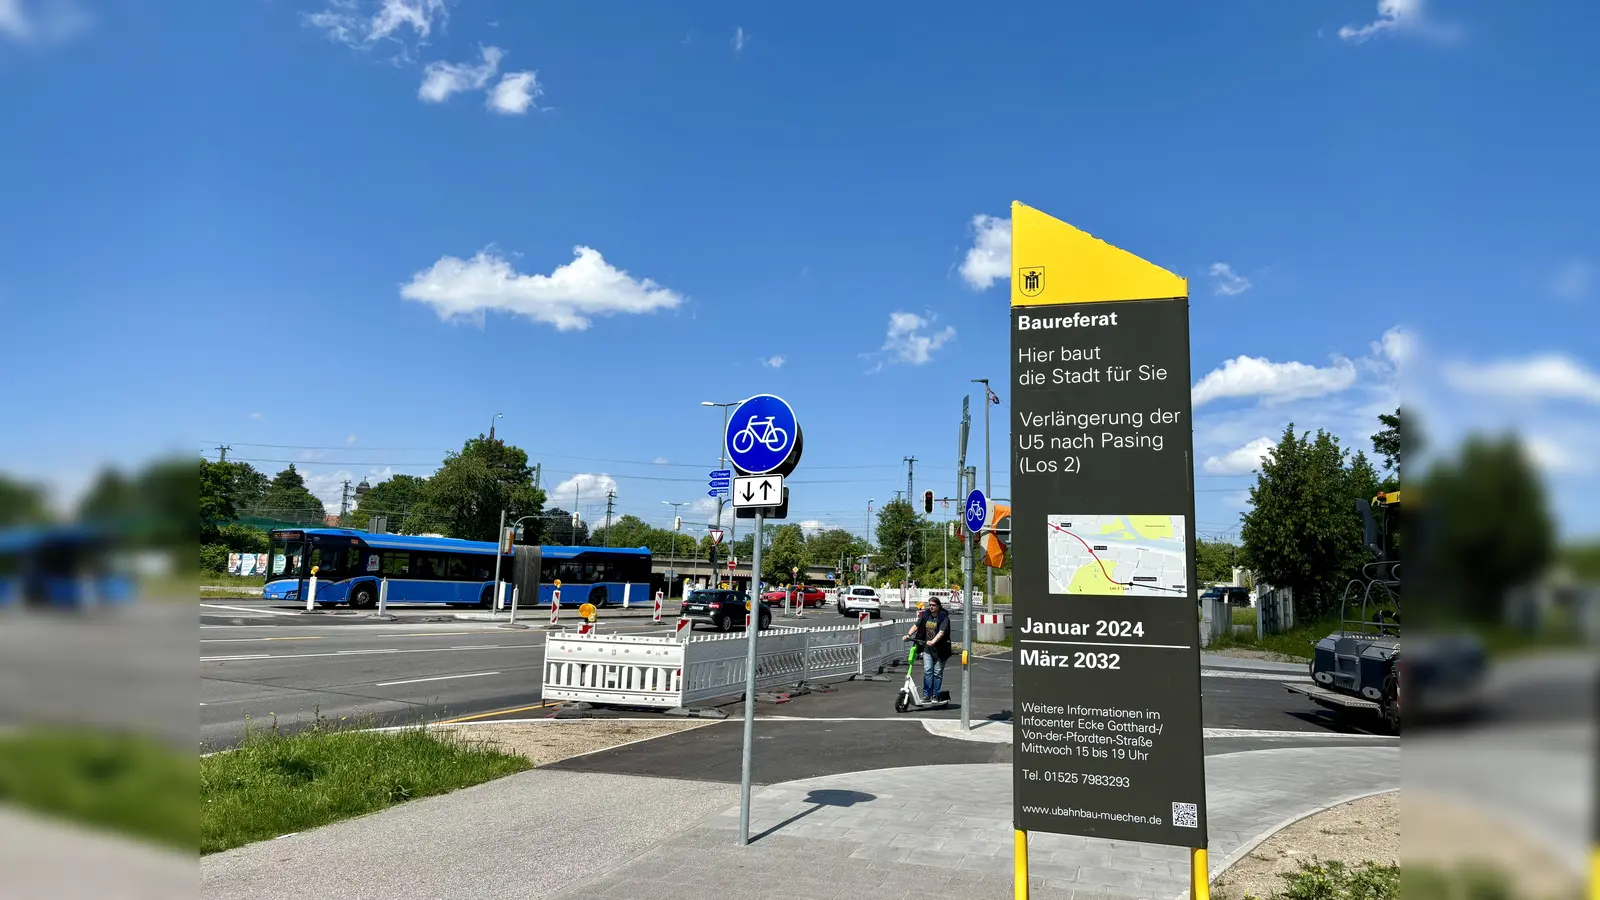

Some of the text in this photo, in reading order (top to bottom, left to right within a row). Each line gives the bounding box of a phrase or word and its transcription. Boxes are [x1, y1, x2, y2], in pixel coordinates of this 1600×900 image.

[1019, 312, 1117, 330] Baureferat
[1019, 346, 1101, 363] Hier baut
[1019, 365, 1167, 385] die Stadt für Sie
[1020, 408, 1180, 429] Verlängerung der
[1020, 432, 1163, 451] U5 nach Pasing
[1020, 456, 1080, 474] (Los 2)
[1021, 617, 1144, 637] Januar 2024
[1021, 649, 1120, 669] März 2032
[1022, 702, 1160, 719] Weitere Informationen im
[1022, 716, 1163, 735] Infocenter Ecke Gotthard-/
[1022, 729, 1153, 748] Von-der-Pfordten-Straße
[1022, 742, 1148, 760] Mittwoch 15 bis 19 Uhr
[1022, 769, 1129, 787] Tel. 01525 7983293
[1022, 805, 1162, 825] www.ubahnbau-muechen.de
